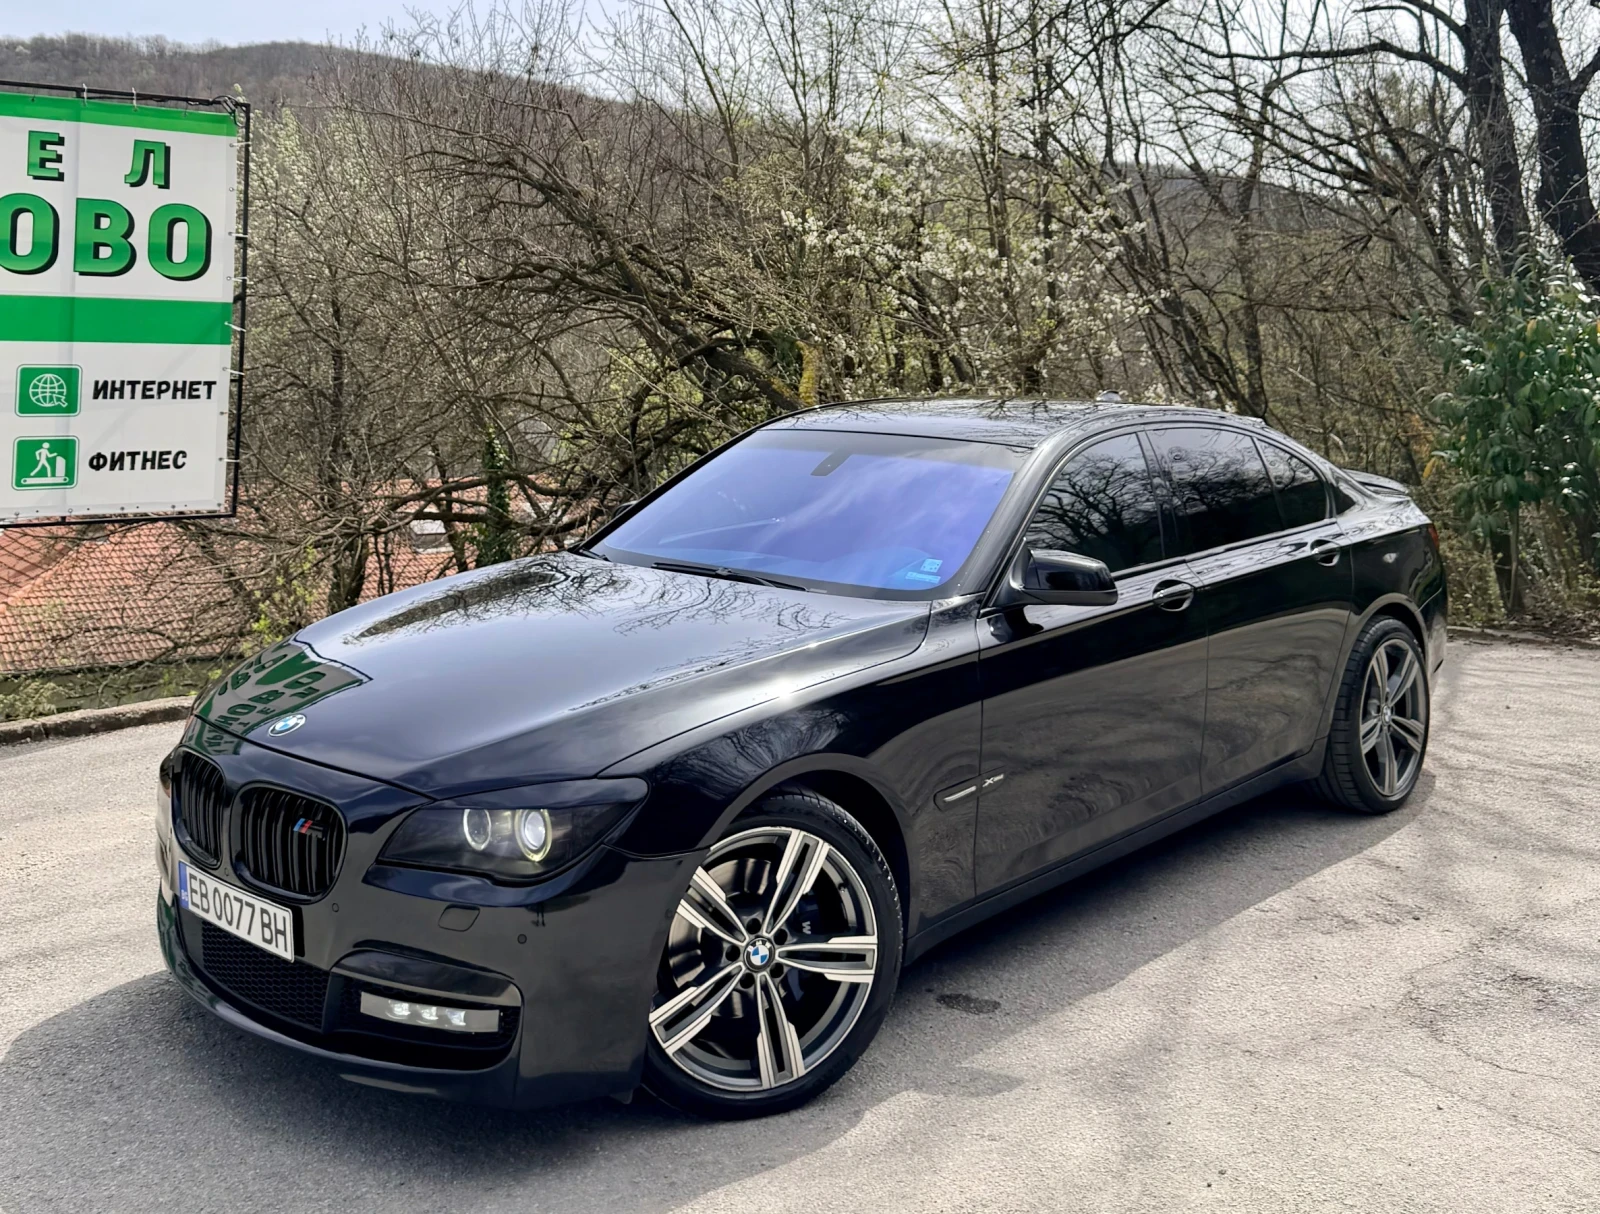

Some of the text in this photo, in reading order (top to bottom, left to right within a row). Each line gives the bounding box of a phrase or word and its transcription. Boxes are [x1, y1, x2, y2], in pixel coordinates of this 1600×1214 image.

[0, 192, 212, 281] ОВО
[92, 380, 217, 400] ИНТЕРНЕТ
[88, 450, 188, 472] ФИТНЕС
[212, 886, 256, 936] 0077
